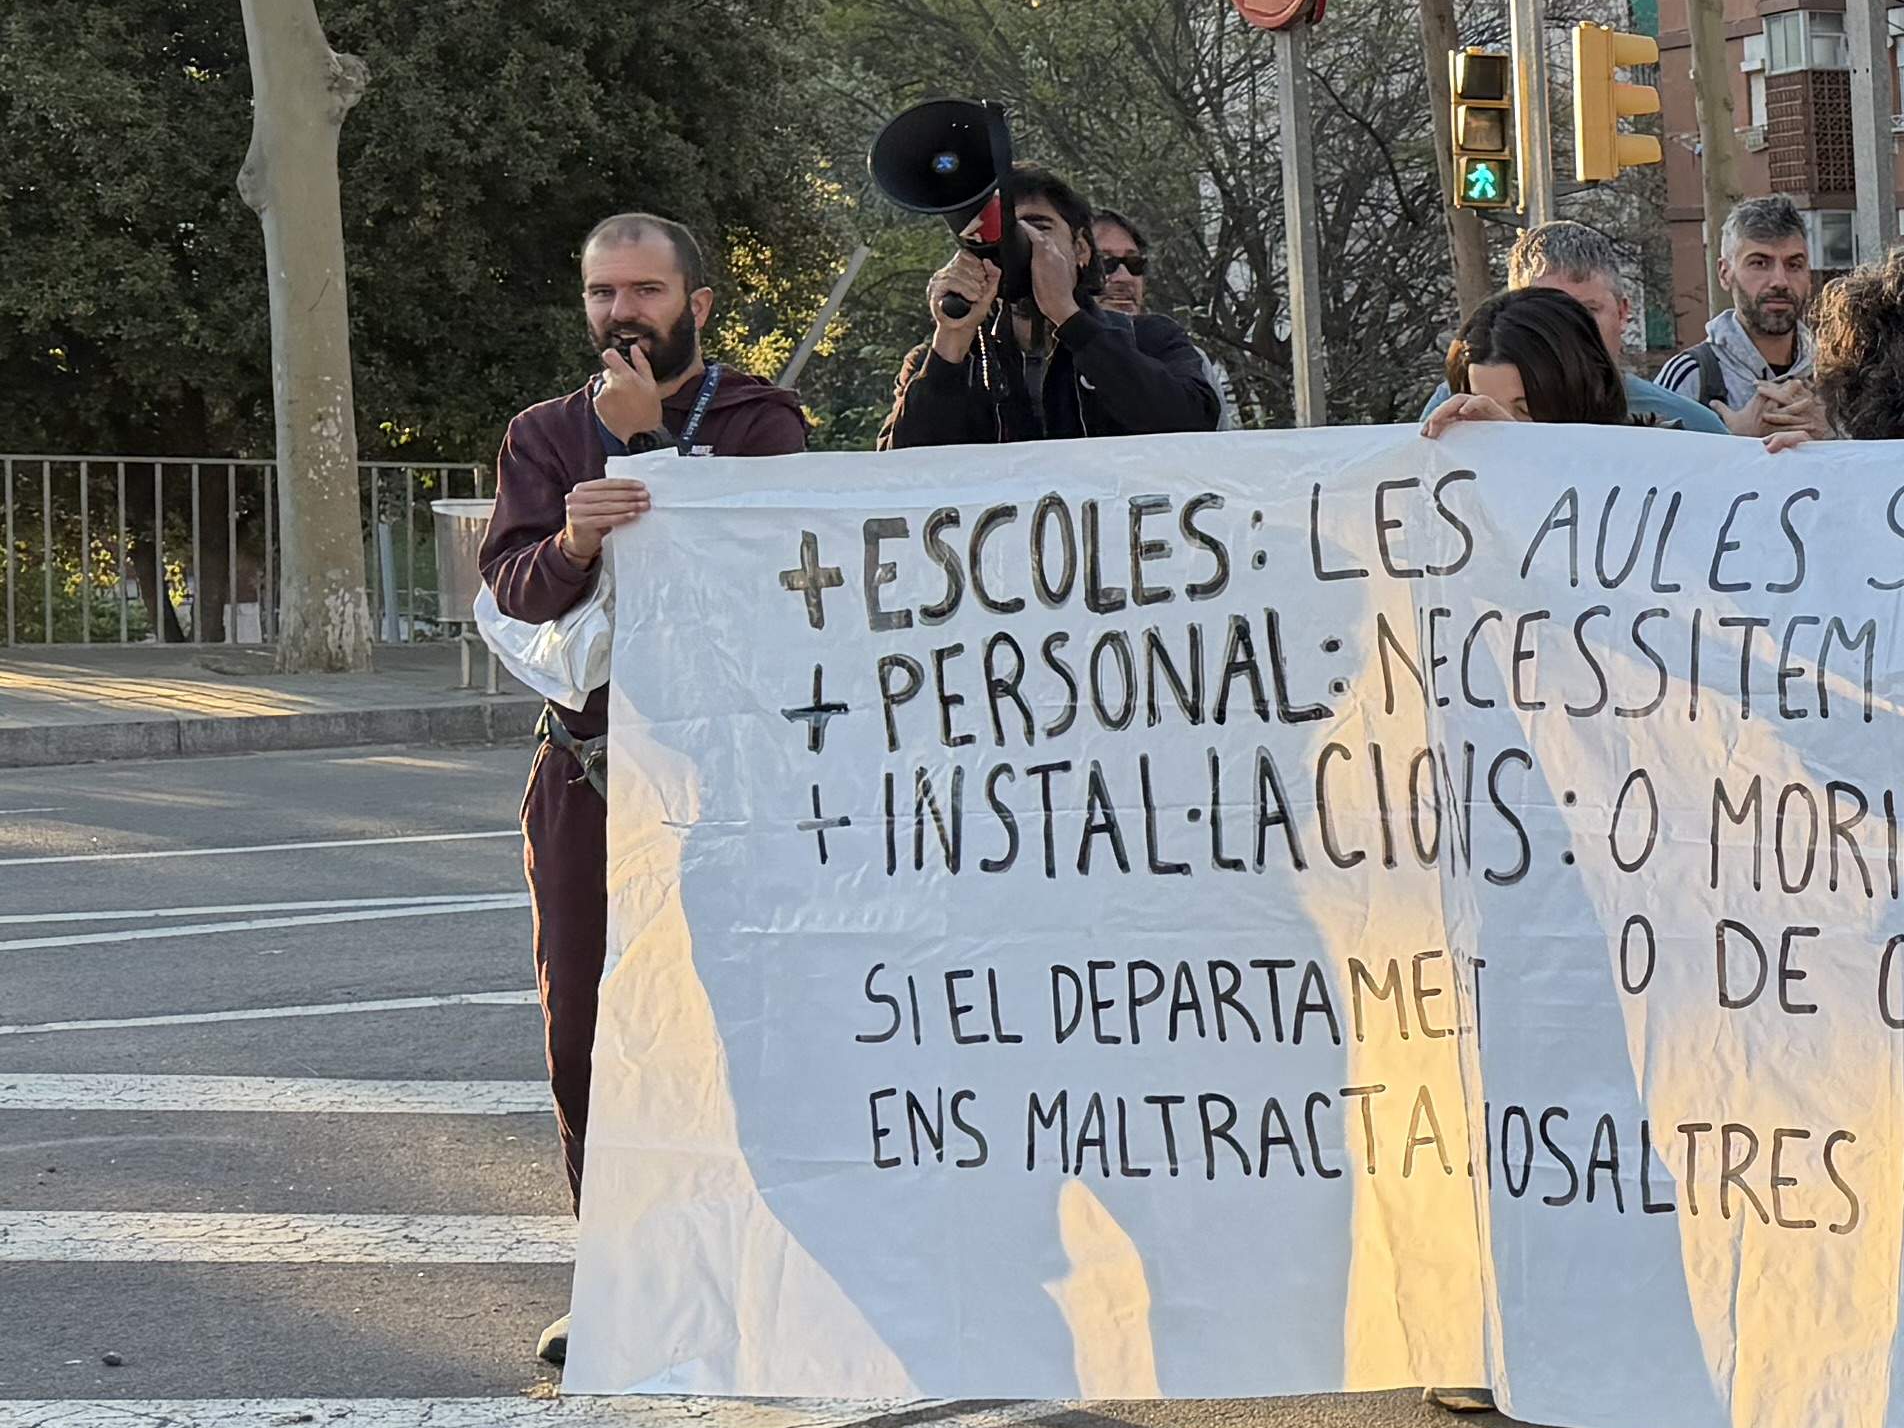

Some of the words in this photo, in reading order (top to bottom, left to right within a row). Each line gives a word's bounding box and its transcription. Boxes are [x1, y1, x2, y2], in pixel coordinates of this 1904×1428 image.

[863, 492, 1267, 631] ESCOLES:
[1311, 470, 1477, 582] LES
[1519, 486, 1820, 596] AULES
[878, 608, 1346, 753] PERSONAL:
[1377, 605, 1877, 723] NECESSITEM
[1609, 768, 1660, 872] O
[855, 962, 922, 1046] SI
[947, 967, 1024, 1044] EL
[1052, 949, 1486, 1049] DEPARTAMET
[1620, 915, 1655, 994] O
[1715, 919, 1820, 1014] DE
[870, 1087, 990, 1169] ENS
[1025, 1084, 1453, 1179] MALTRACTA
